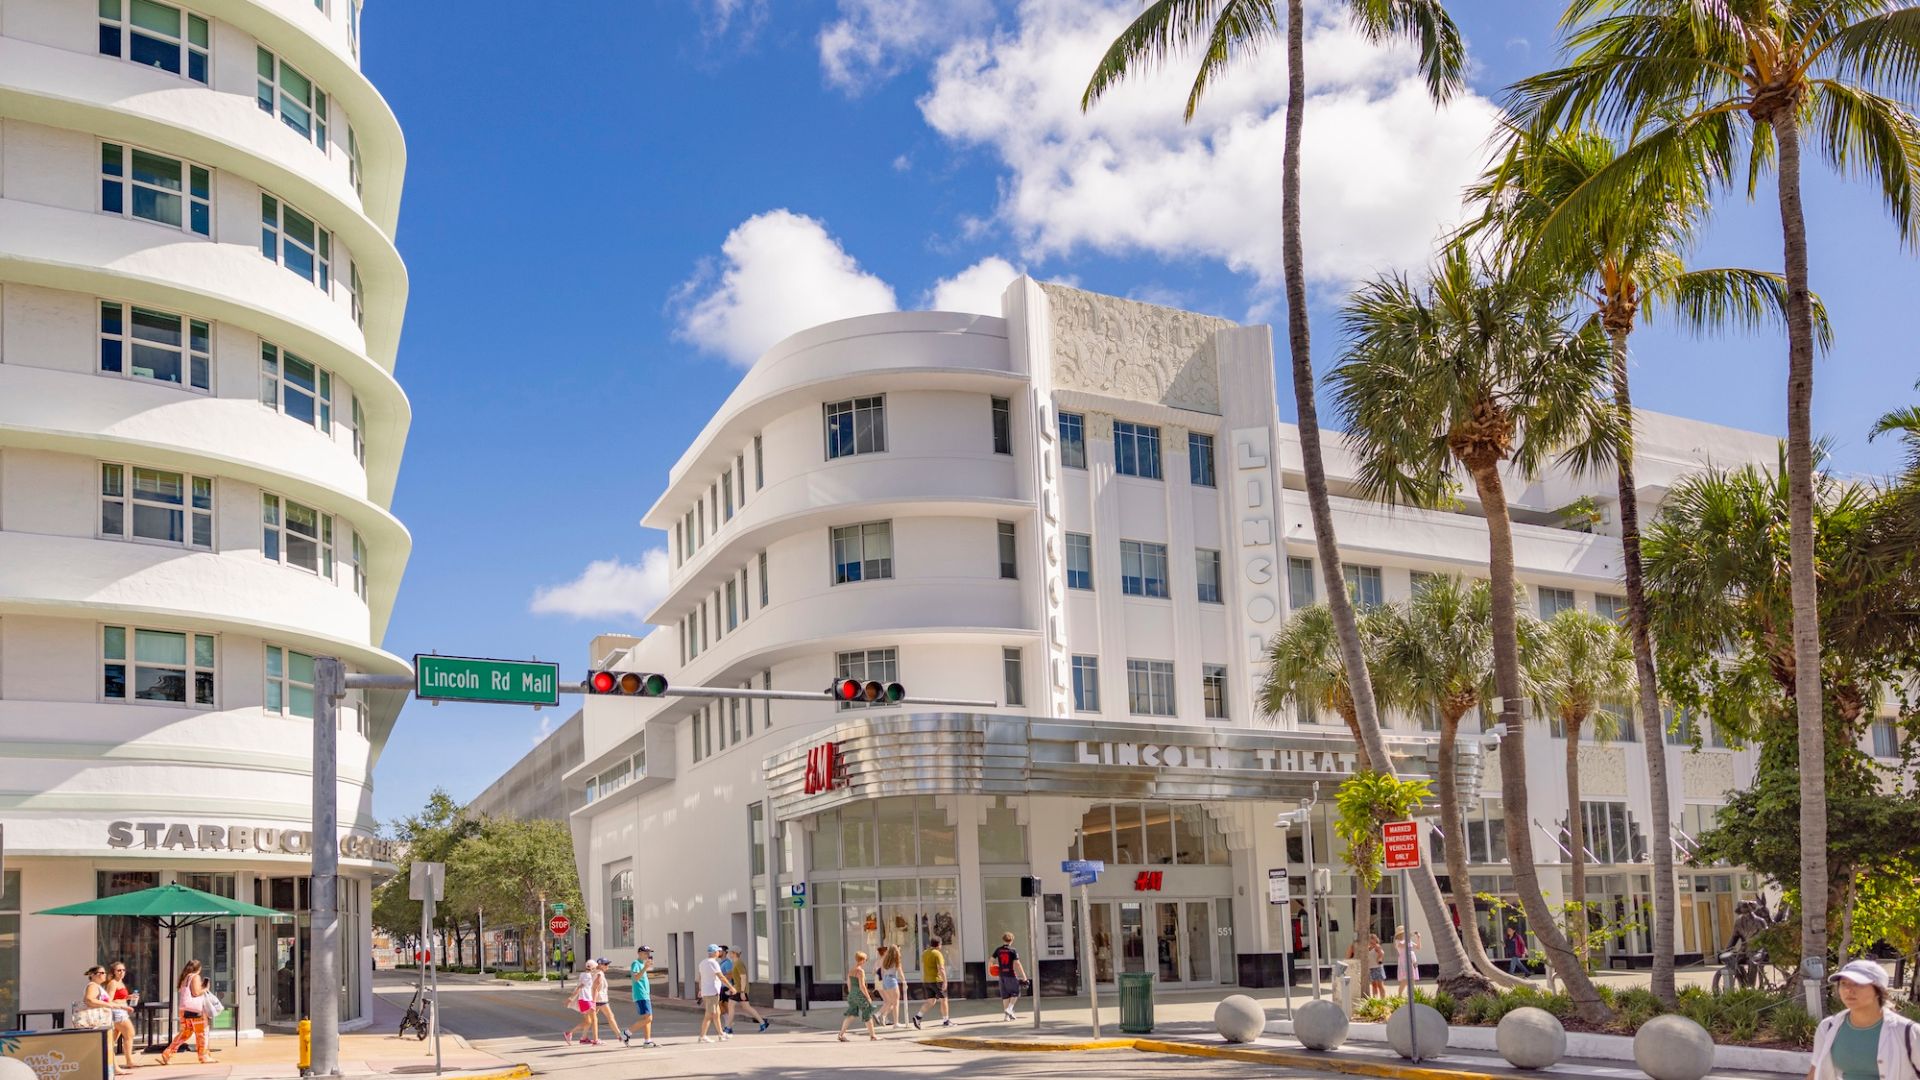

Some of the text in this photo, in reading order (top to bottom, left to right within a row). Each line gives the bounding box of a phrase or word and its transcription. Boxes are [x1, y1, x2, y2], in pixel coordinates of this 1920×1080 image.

[425, 666, 551, 693] Lincoln Rd Mall
[1078, 741, 1356, 773] LINCOLN THEAT
[107, 821, 313, 853] STARBUC
[551, 921, 568, 929] STOP
[1217, 927, 1232, 936] 551
